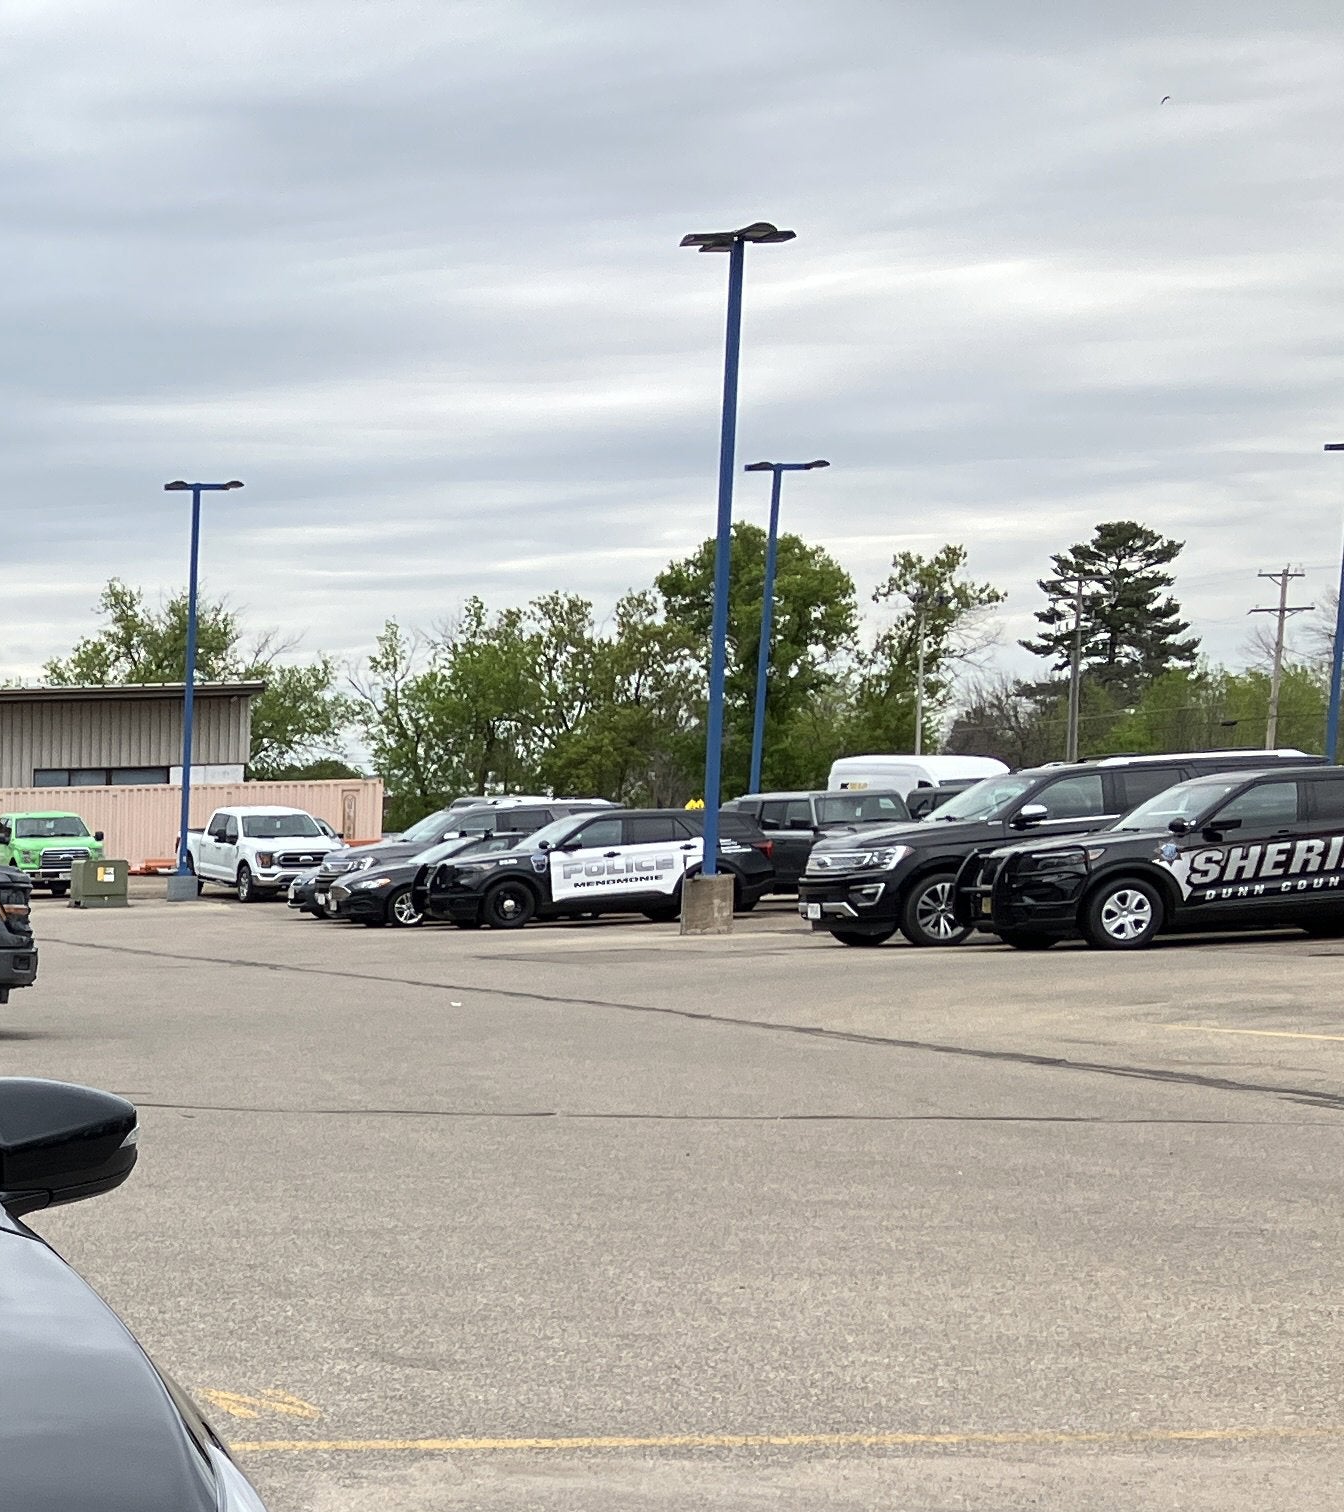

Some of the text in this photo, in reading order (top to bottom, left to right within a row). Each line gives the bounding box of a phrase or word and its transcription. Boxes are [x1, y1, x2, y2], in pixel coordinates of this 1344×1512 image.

[563, 854, 674, 880] POLICE
[1189, 836, 1344, 884] SHERI
[573, 874, 664, 888] MENOMONIE
[1205, 884, 1265, 901] DUNN
